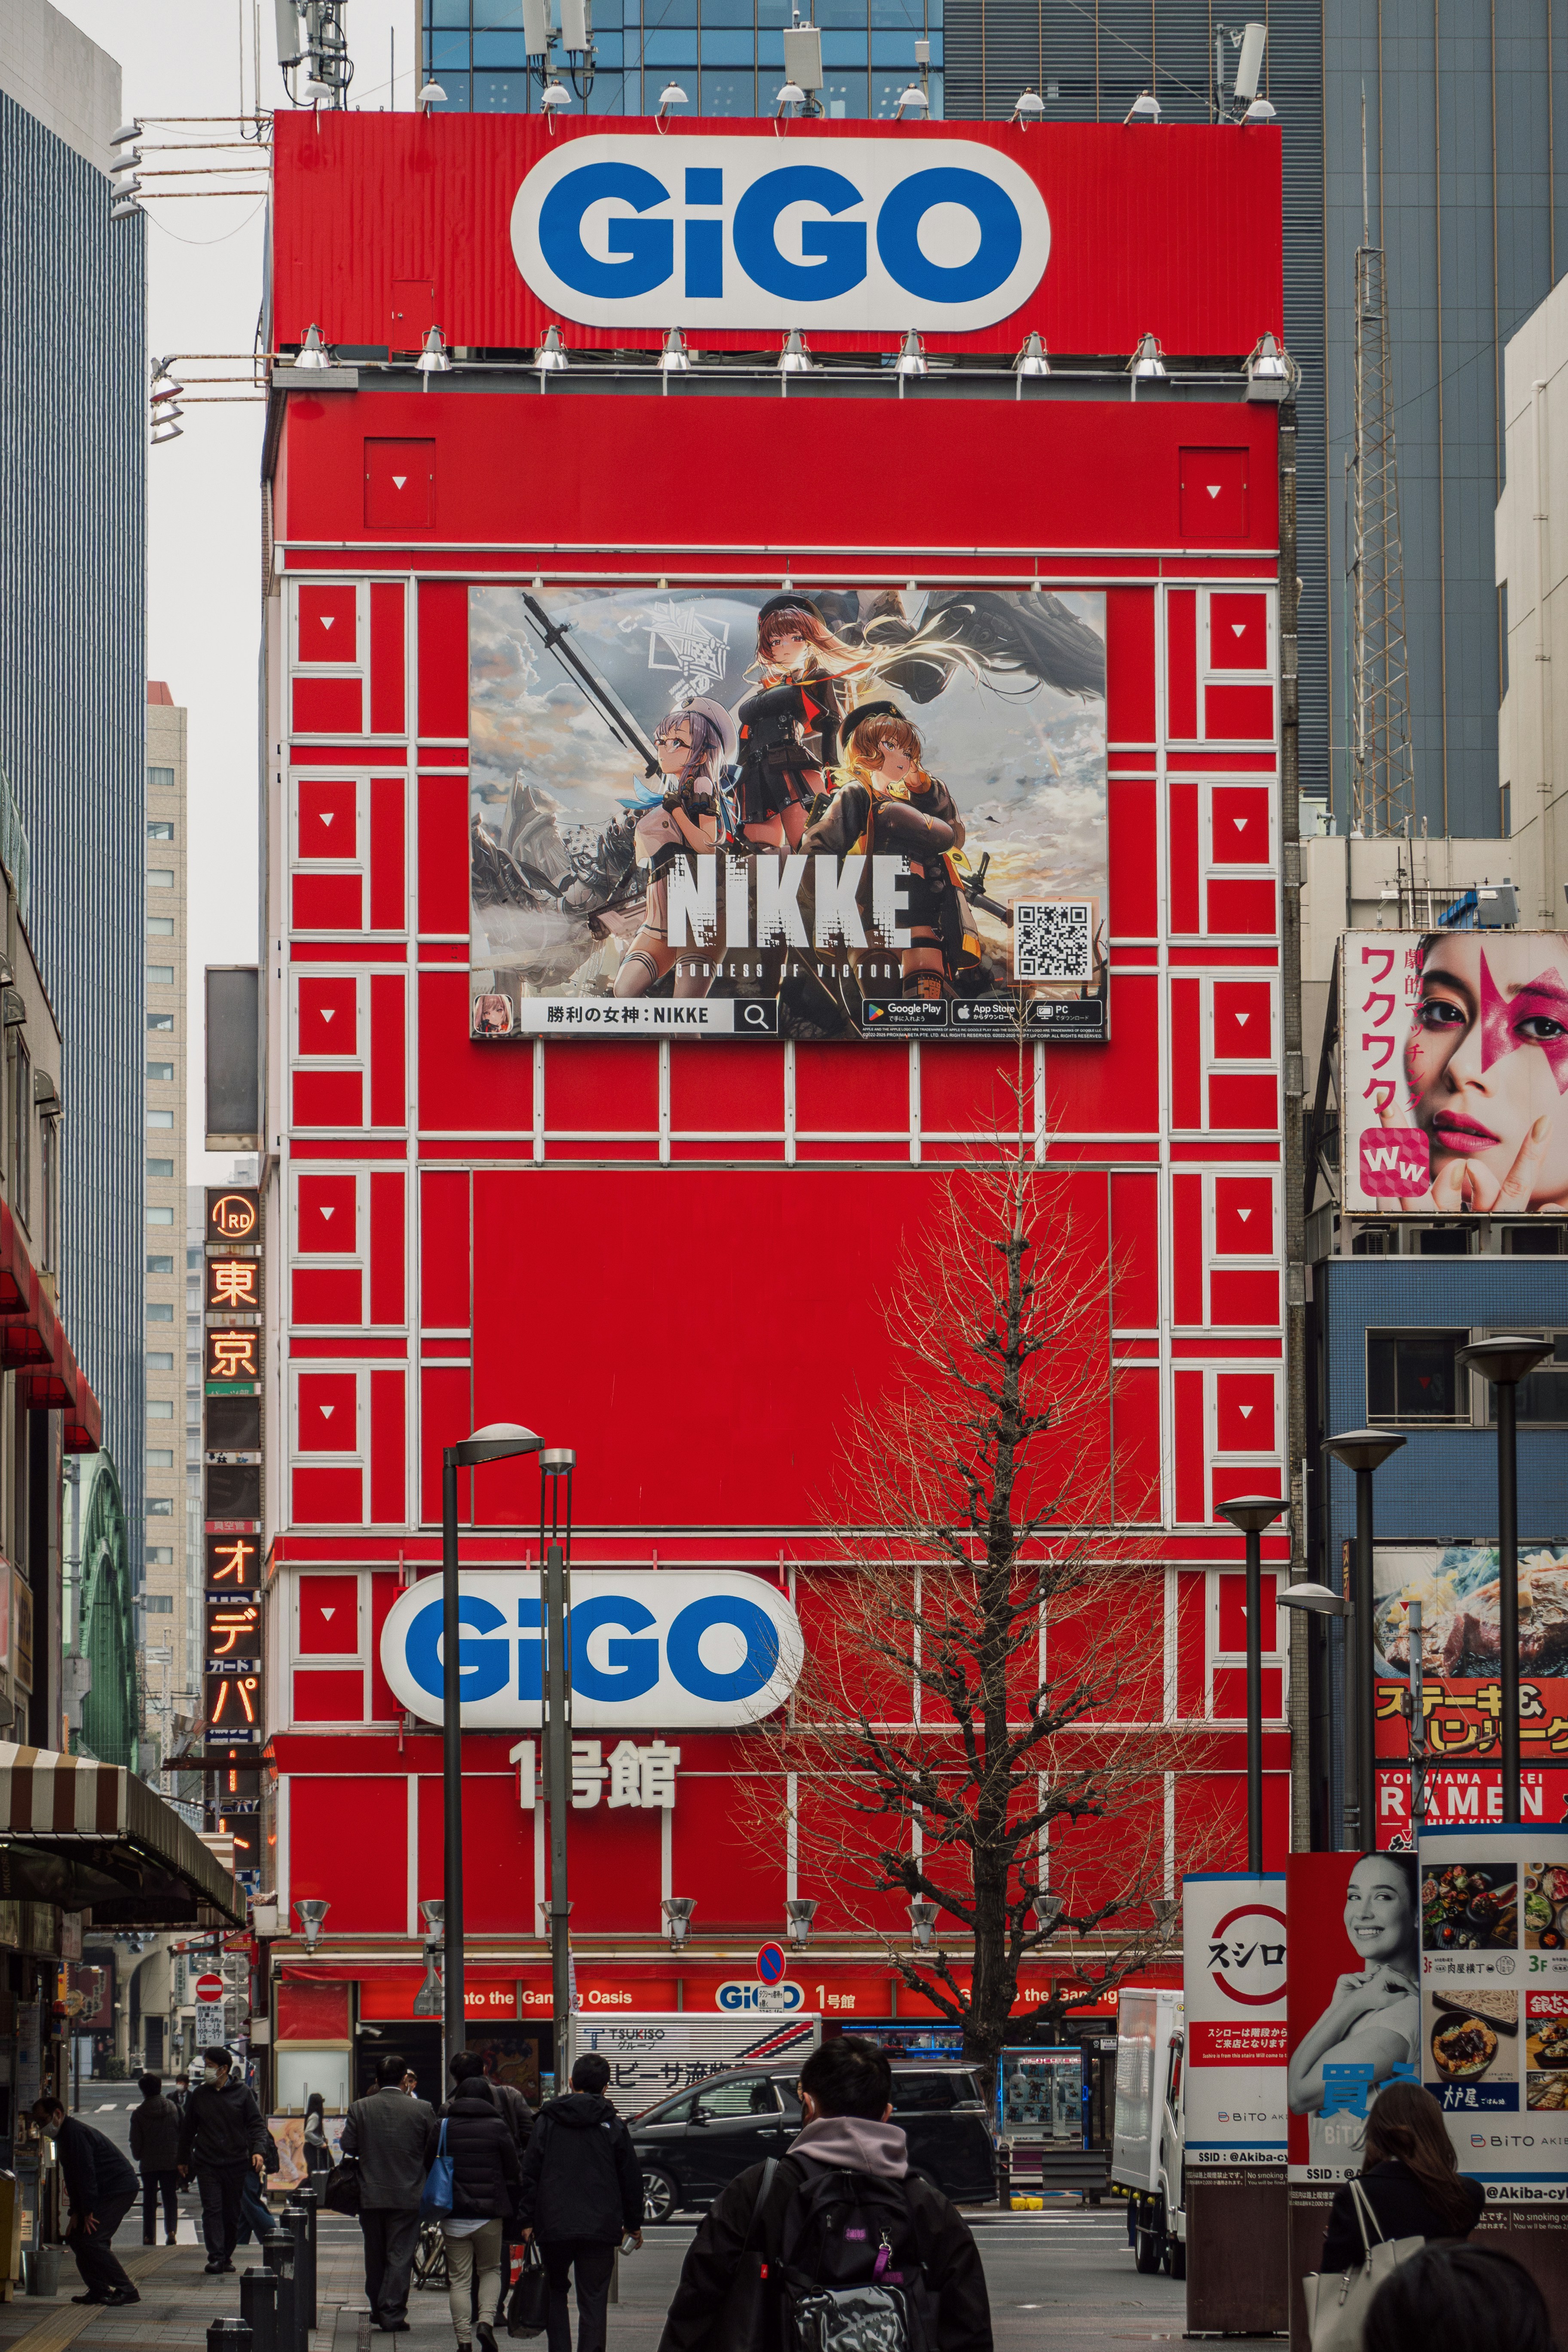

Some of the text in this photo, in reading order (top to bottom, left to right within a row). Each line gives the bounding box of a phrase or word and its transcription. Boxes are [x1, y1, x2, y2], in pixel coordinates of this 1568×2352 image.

[539, 162, 1022, 303] GiGO
[667, 854, 911, 948] NIKKE
[676, 964, 904, 979] GODDESS OF VICTORY
[888, 1003, 941, 1015] Google Play
[973, 1004, 1015, 1014] App Store
[1056, 1005, 1068, 1014] PC
[1361, 946, 1396, 1115] ワクワク
[1404, 948, 1426, 1113] 劇的マッチング
[405, 1595, 779, 1702] GiGO
[509, 1740, 680, 1808] 1号館
[1381, 1786, 1543, 1816] RAMEN
[1424, 1957, 1432, 1973] 3F
[1447, 1962, 1485, 1974] 肉屋横丁
[1528, 1955, 1547, 1972] 3F
[489, 1991, 514, 2004] the
[588, 1990, 633, 2004] Oasis
[816, 1984, 855, 2009] 1号館
[1025, 1988, 1049, 2002] the
[609, 2029, 665, 2040] TSUKISO
[1208, 2028, 1287, 2037] スシローは階段から
[618, 2040, 657, 2050] グループ
[1215, 2039, 1287, 2049] ご来店となります
[1443, 2084, 1479, 2109] 大戸屋
[1232, 2112, 1267, 2122] BiTO
[1490, 2135, 1534, 2147] BiTO
[1198, 2152, 1220, 2162] SSID
[1307, 2168, 1332, 2179] SSID
[1513, 2213, 1525, 2221] No
[1526, 2213, 1560, 2223] smoking
